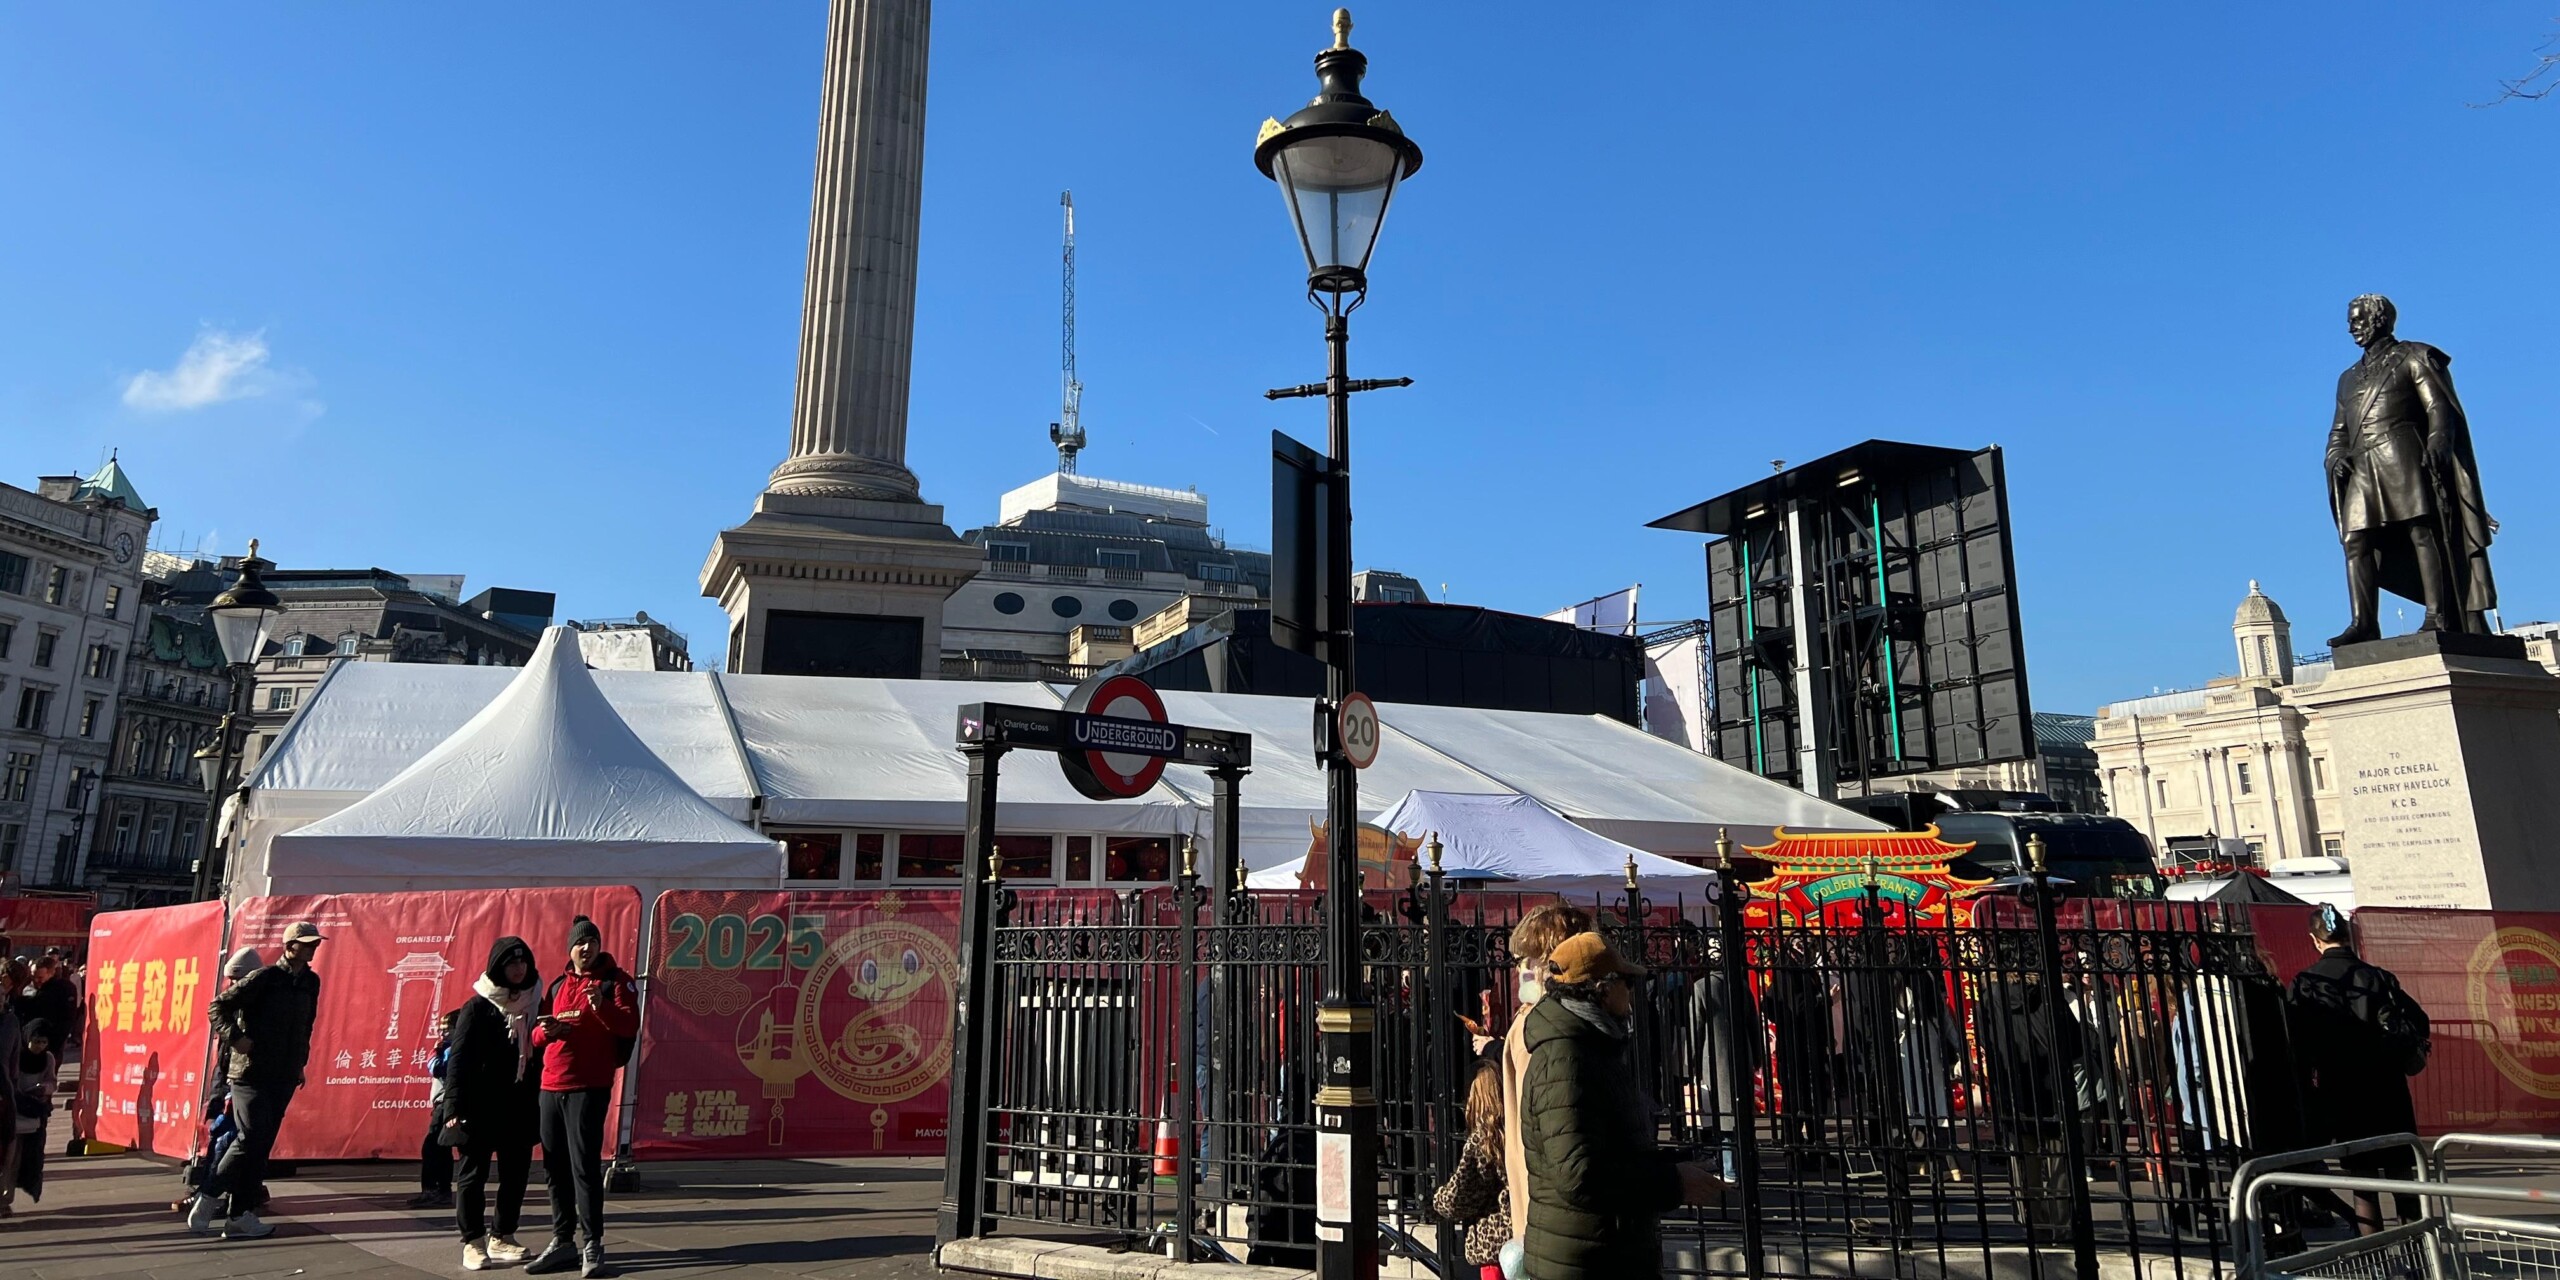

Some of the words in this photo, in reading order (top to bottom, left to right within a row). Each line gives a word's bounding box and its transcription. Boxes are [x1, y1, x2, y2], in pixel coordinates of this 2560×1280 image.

[1003, 718, 1029, 732] Charing
[1030, 722, 1049, 732] Cross
[1345, 713, 1375, 748] 20
[1075, 718, 1176, 751] UNDERGROUND
[2359, 767, 2390, 778] MAJOR
[2394, 763, 2439, 775] GENERAL
[2353, 786, 2368, 795] SIR
[2371, 782, 2401, 794] HENRY
[2403, 778, 2451, 791] HAVELOCK
[2411, 811, 2452, 819] COMPANIONS
[1813, 879, 1856, 901] GOLDEN
[1858, 877, 1919, 901] ERANCE
[396, 936, 442, 944] ORGANISED
[444, 935, 456, 943] BY
[667, 914, 825, 970] 2025
[95, 956, 199, 1035] 恭喜發財
[2499, 1016, 2536, 1034] NEW
[326, 1075, 357, 1085] London
[358, 1075, 402, 1085] Chinatown
[372, 1099, 433, 1109] LCCAUK.COM
[694, 1090, 738, 1106] YEAR
[692, 1105, 717, 1121] OF
[718, 1105, 750, 1121] THE
[692, 1120, 749, 1137] SNAKE
